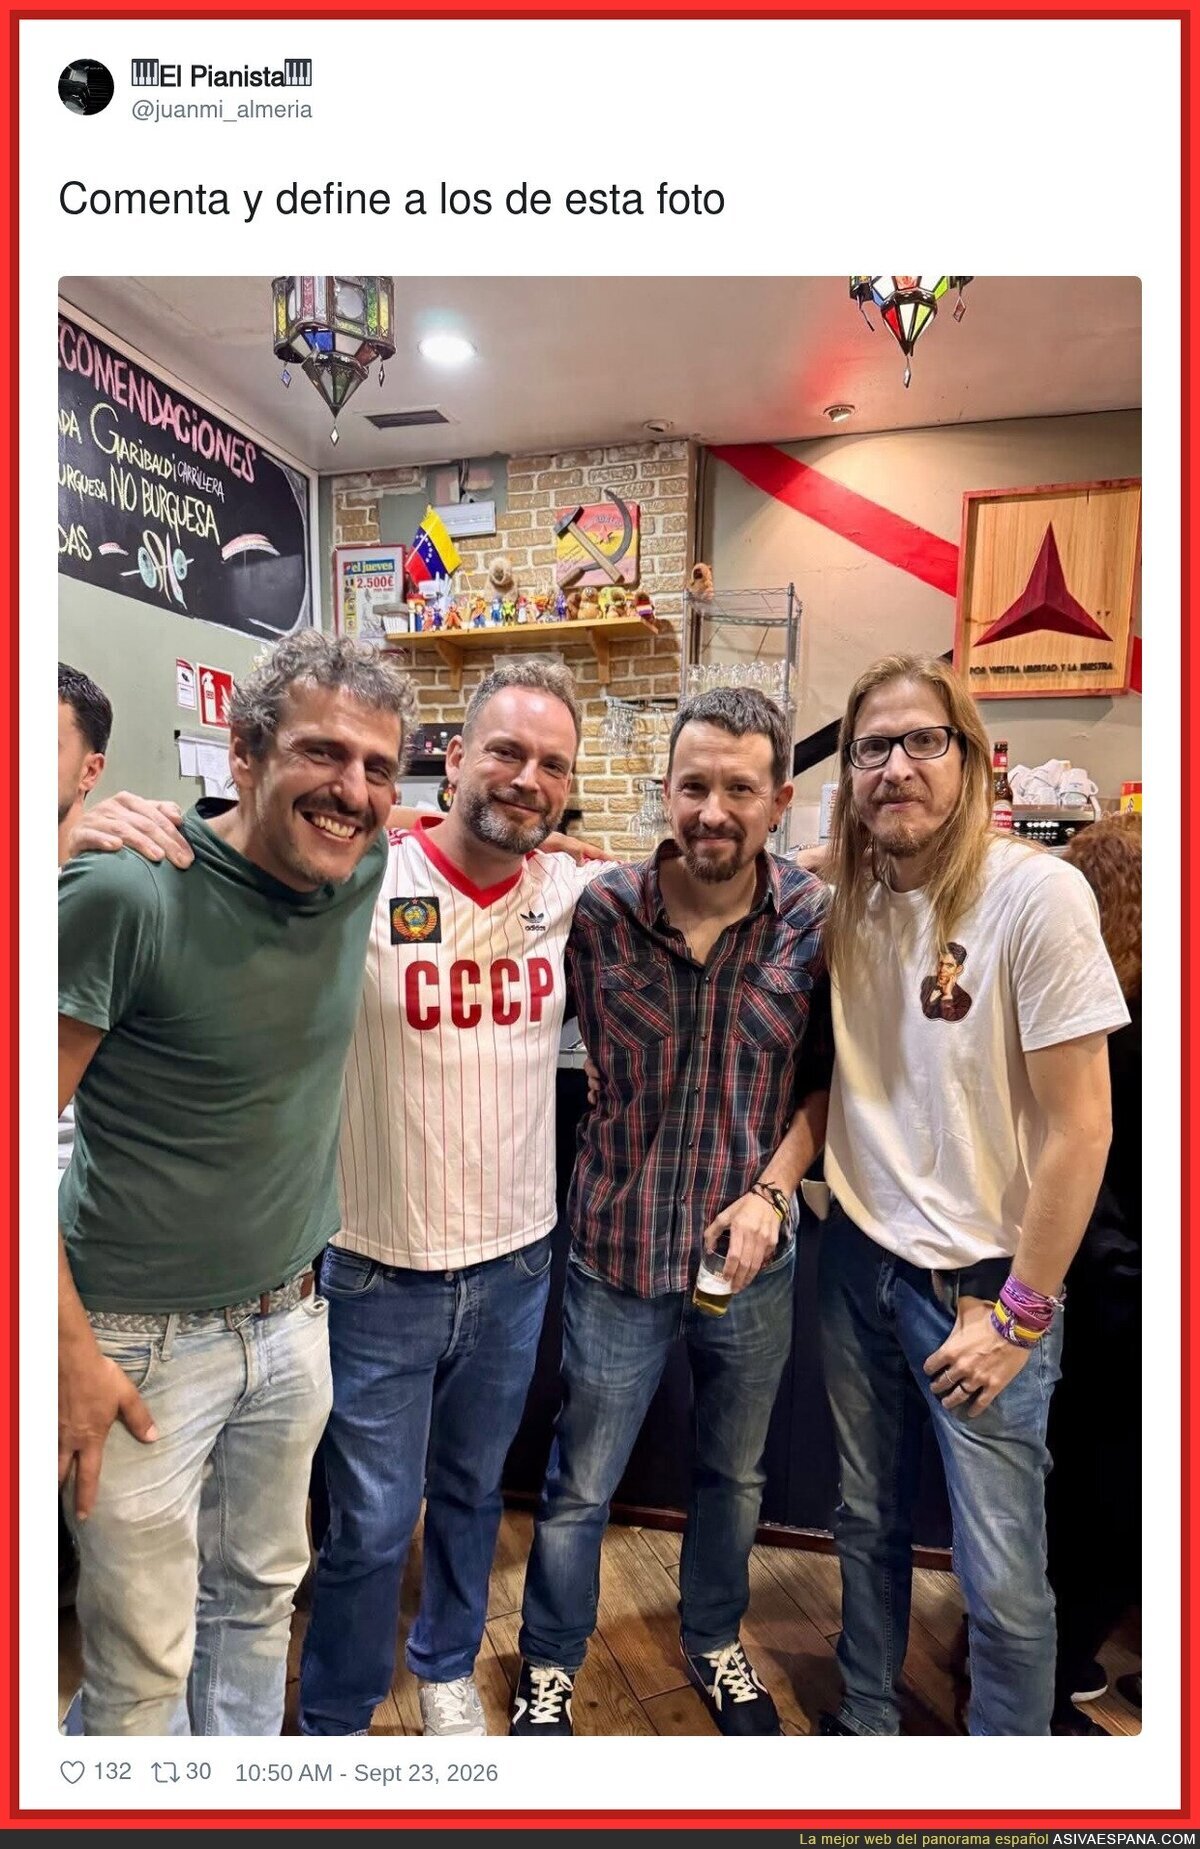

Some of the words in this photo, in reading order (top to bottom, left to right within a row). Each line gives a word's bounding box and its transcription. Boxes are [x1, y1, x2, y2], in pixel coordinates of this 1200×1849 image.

[58, 318, 257, 483] COMENDACiONES
[110, 463, 138, 512] NO
[142, 482, 221, 546] BURGUESA
[356, 575, 394, 588] 2.500€
[362, 560, 394, 573] jueves
[524, 924, 546, 932] adidas
[405, 957, 554, 1031] CCCP
